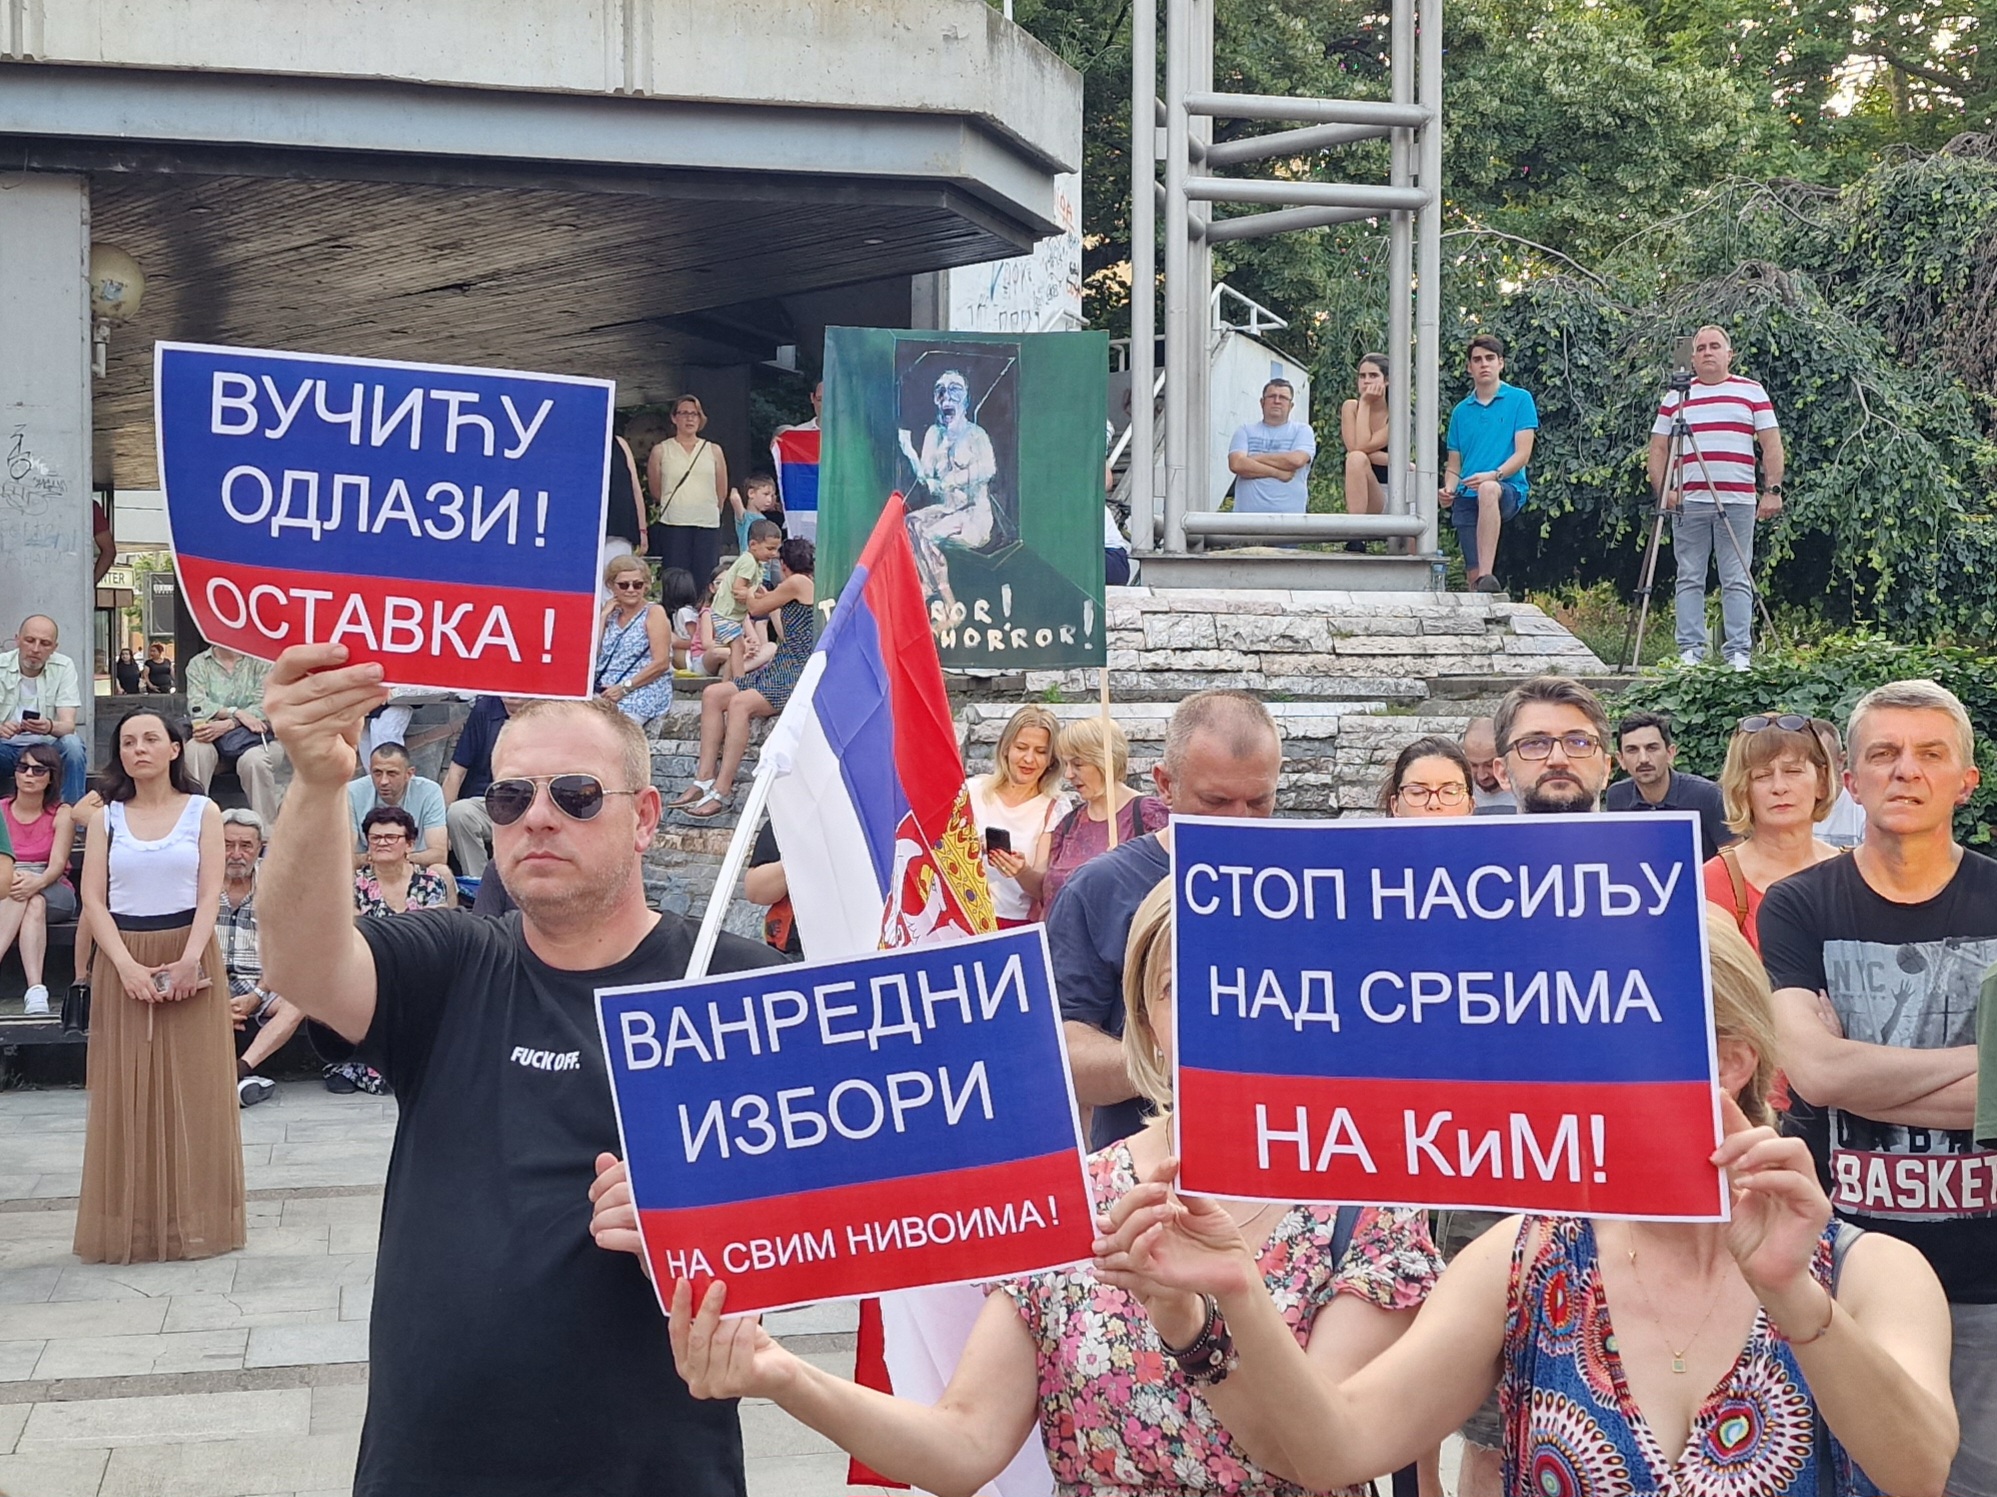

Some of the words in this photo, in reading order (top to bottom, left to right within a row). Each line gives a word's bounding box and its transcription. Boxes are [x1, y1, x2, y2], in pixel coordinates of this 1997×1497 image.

[211, 371, 554, 459] ВУЧИЋУ
[221, 465, 549, 547] ОДЛАЗИ!
[1185, 863, 1346, 920] СТОП
[1371, 862, 1683, 920] НАСИЉУ
[619, 954, 1030, 1071] ВАНРЕДНИ
[1210, 965, 1340, 1033] НАД
[1360, 969, 1662, 1024] СРБИМА
[510, 1046, 553, 1071] FUCK
[553, 1050, 581, 1072] OFF.
[678, 1060, 995, 1163] ИЗБОРИ
[1255, 1104, 1377, 1174] НА
[1404, 1109, 1607, 1184] КиМ!
[666, 1248, 715, 1280] НА
[723, 1229, 836, 1273] СВИМ
